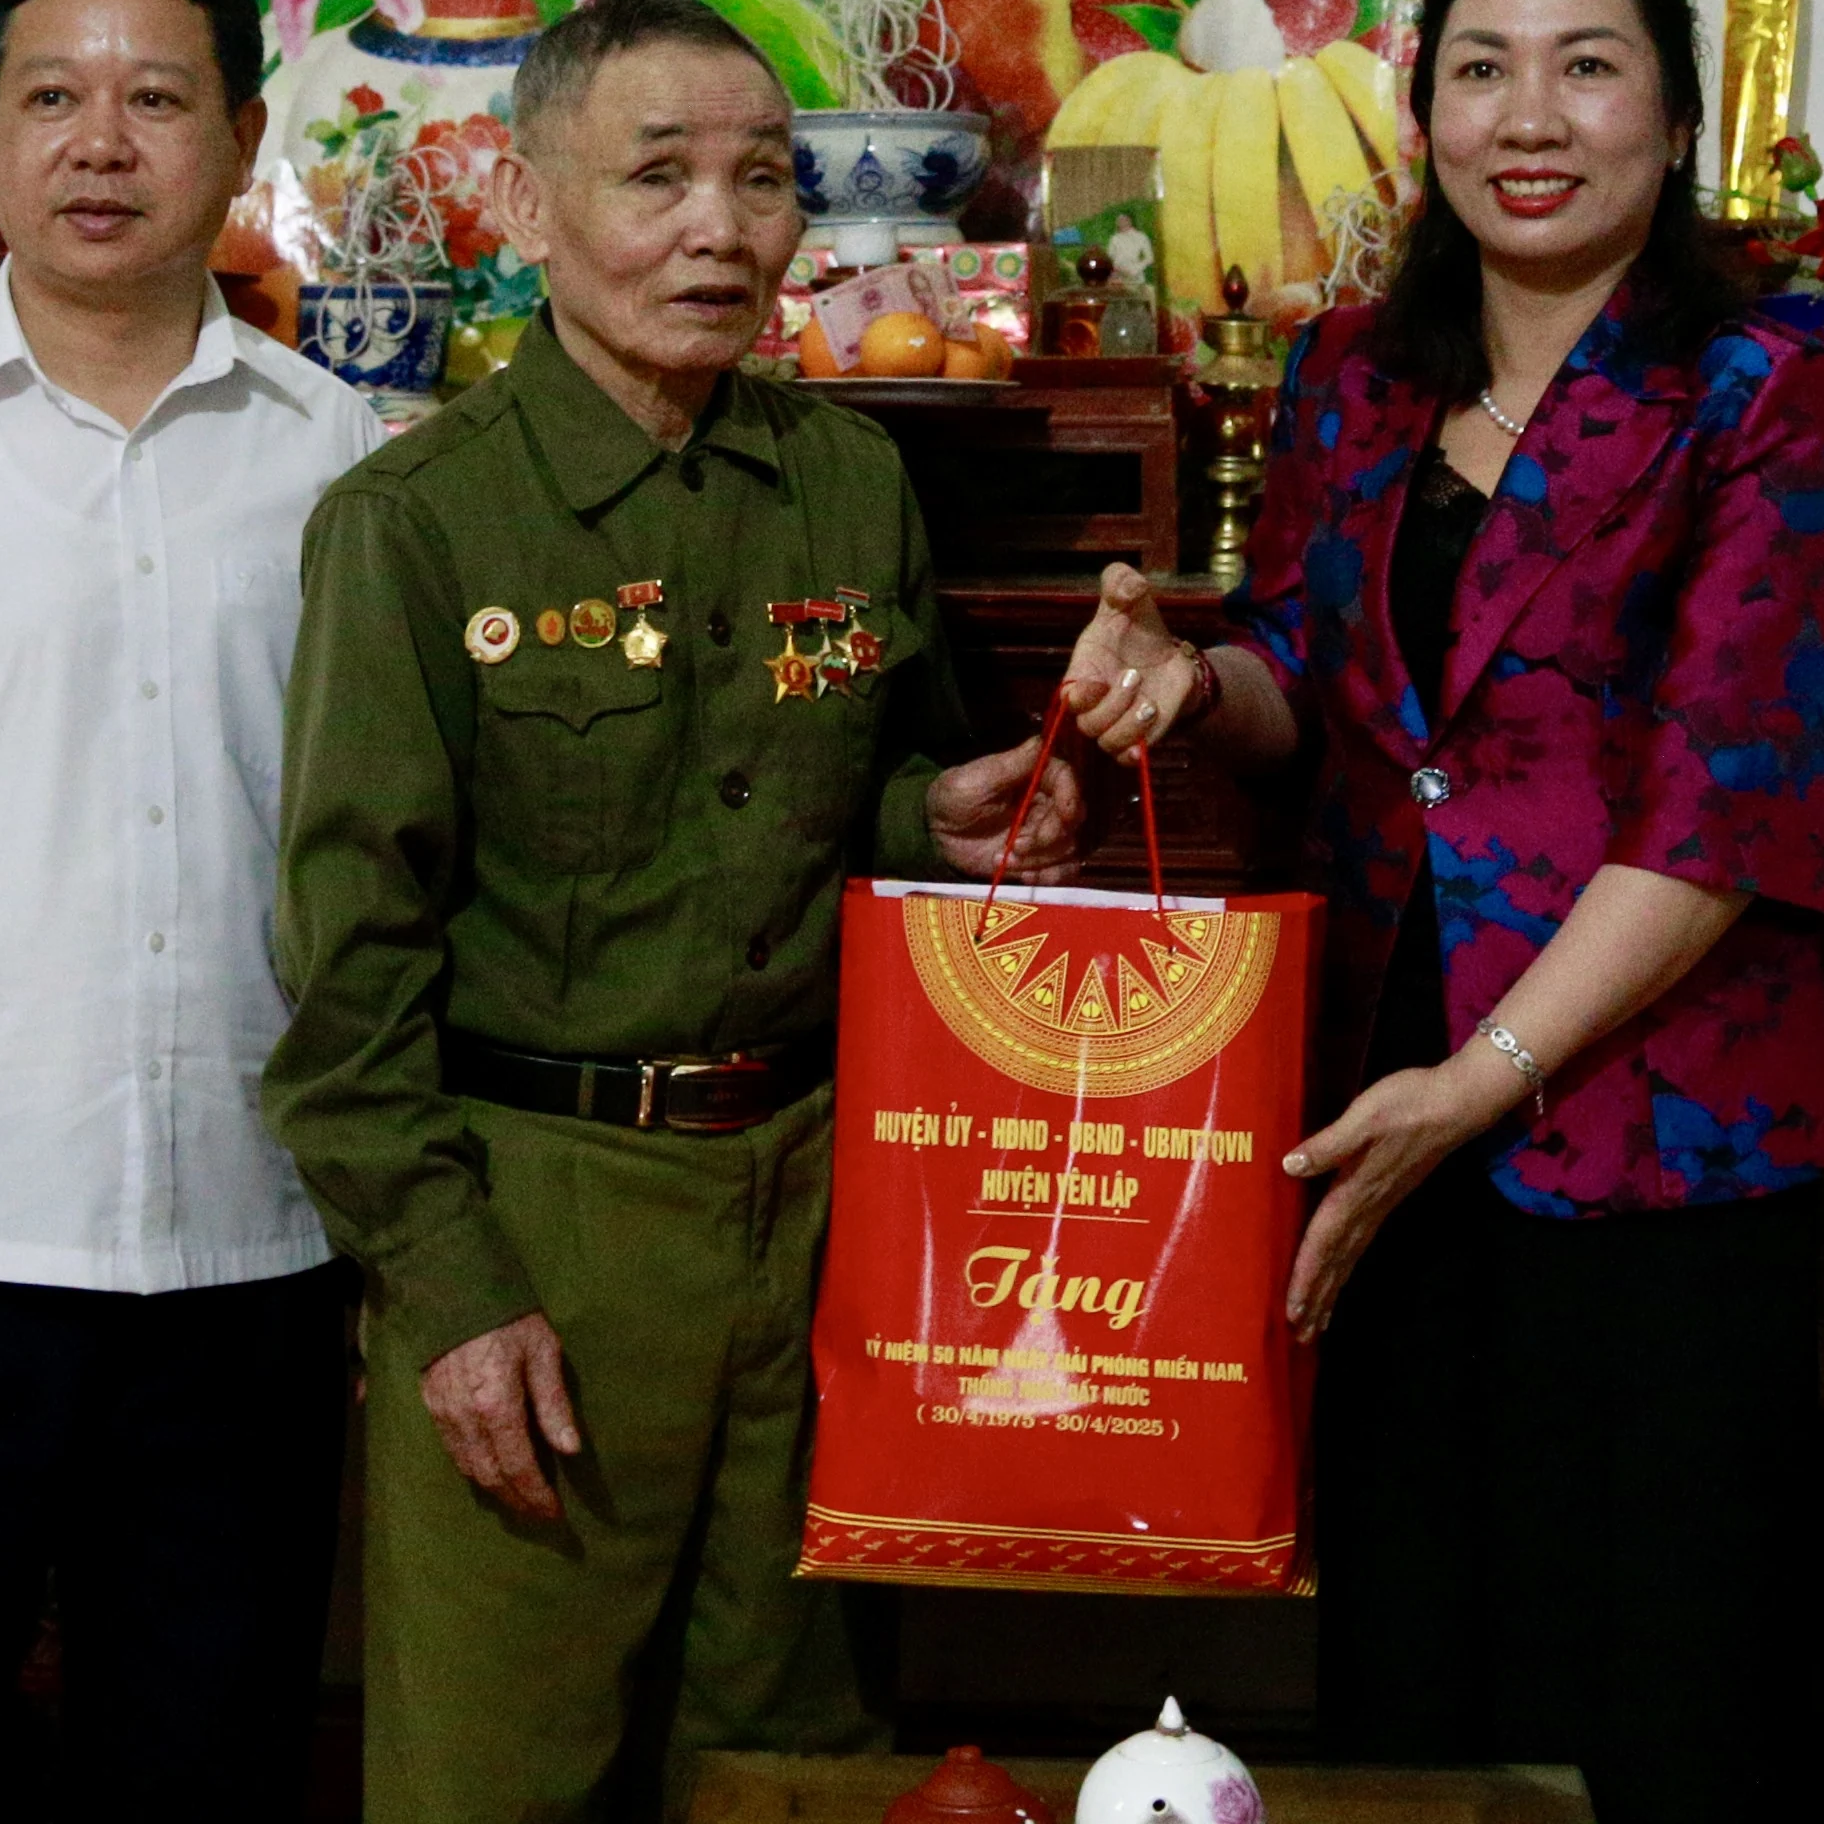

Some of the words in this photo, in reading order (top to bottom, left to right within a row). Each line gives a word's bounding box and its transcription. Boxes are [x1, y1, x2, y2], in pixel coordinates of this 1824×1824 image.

[874, 1106, 940, 1152] HUYỆN
[945, 1101, 974, 1148] ỦY
[992, 1117, 1049, 1152] HĐND
[1069, 1121, 1125, 1156] UBND
[1143, 1125, 1253, 1166] UBMTTQVN
[981, 1164, 1050, 1210] HUYỆN
[1056, 1167, 1096, 1206] YÊN
[1100, 1169, 1139, 1216] LẬP
[965, 1246, 1149, 1331] Tặng
[866, 1332, 883, 1358] KỶ
[885, 1339, 929, 1366] NIỆM
[932, 1345, 955, 1365] 50
[959, 1344, 999, 1367] NĂM
[1053, 1345, 1088, 1374] GIẢI
[1091, 1353, 1150, 1378] PHÓNG
[1203, 1362, 1248, 1384] NAM,
[958, 1370, 1013, 1398] THỐNG
[1067, 1378, 1100, 1403] ĐẤT
[1103, 1382, 1151, 1407] NƯỚC
[931, 1405, 1036, 1429] 30/4/1975
[1055, 1414, 1165, 1437] 30/4/2025
